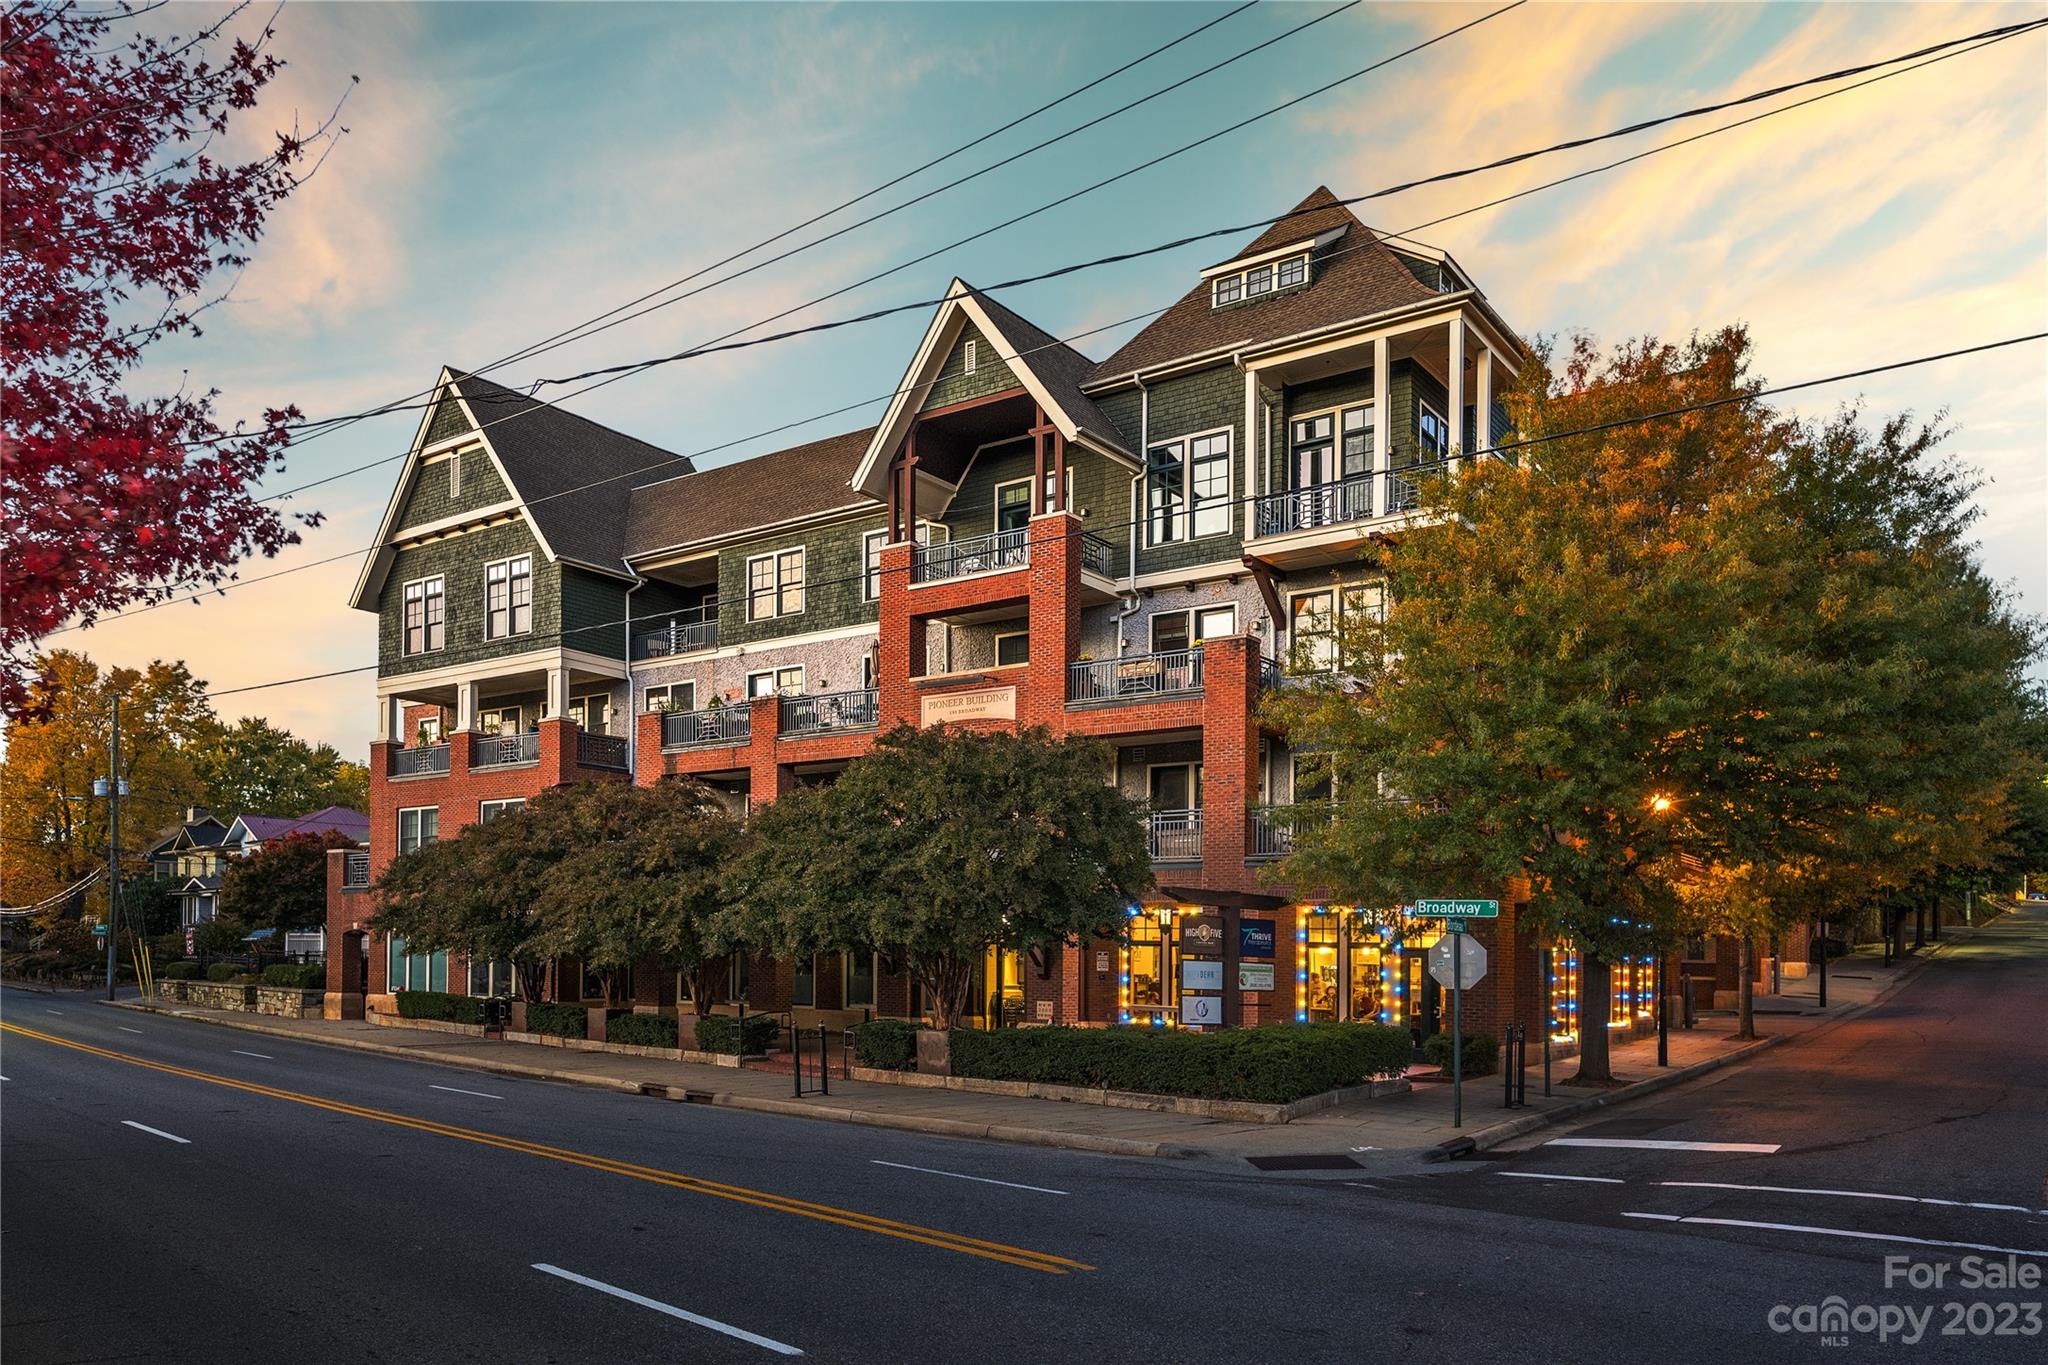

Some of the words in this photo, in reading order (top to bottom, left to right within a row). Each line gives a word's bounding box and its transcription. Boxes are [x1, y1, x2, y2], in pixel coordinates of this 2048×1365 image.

[928, 698, 964, 710] PIONEER
[966, 693, 1008, 705] BUILDING
[1418, 901, 1481, 915] Broadway
[1489, 901, 1495, 909] St
[1185, 928, 1199, 937] HIGH
[1210, 928, 1222, 938] FIVE
[1251, 932, 1272, 941] THRIVE
